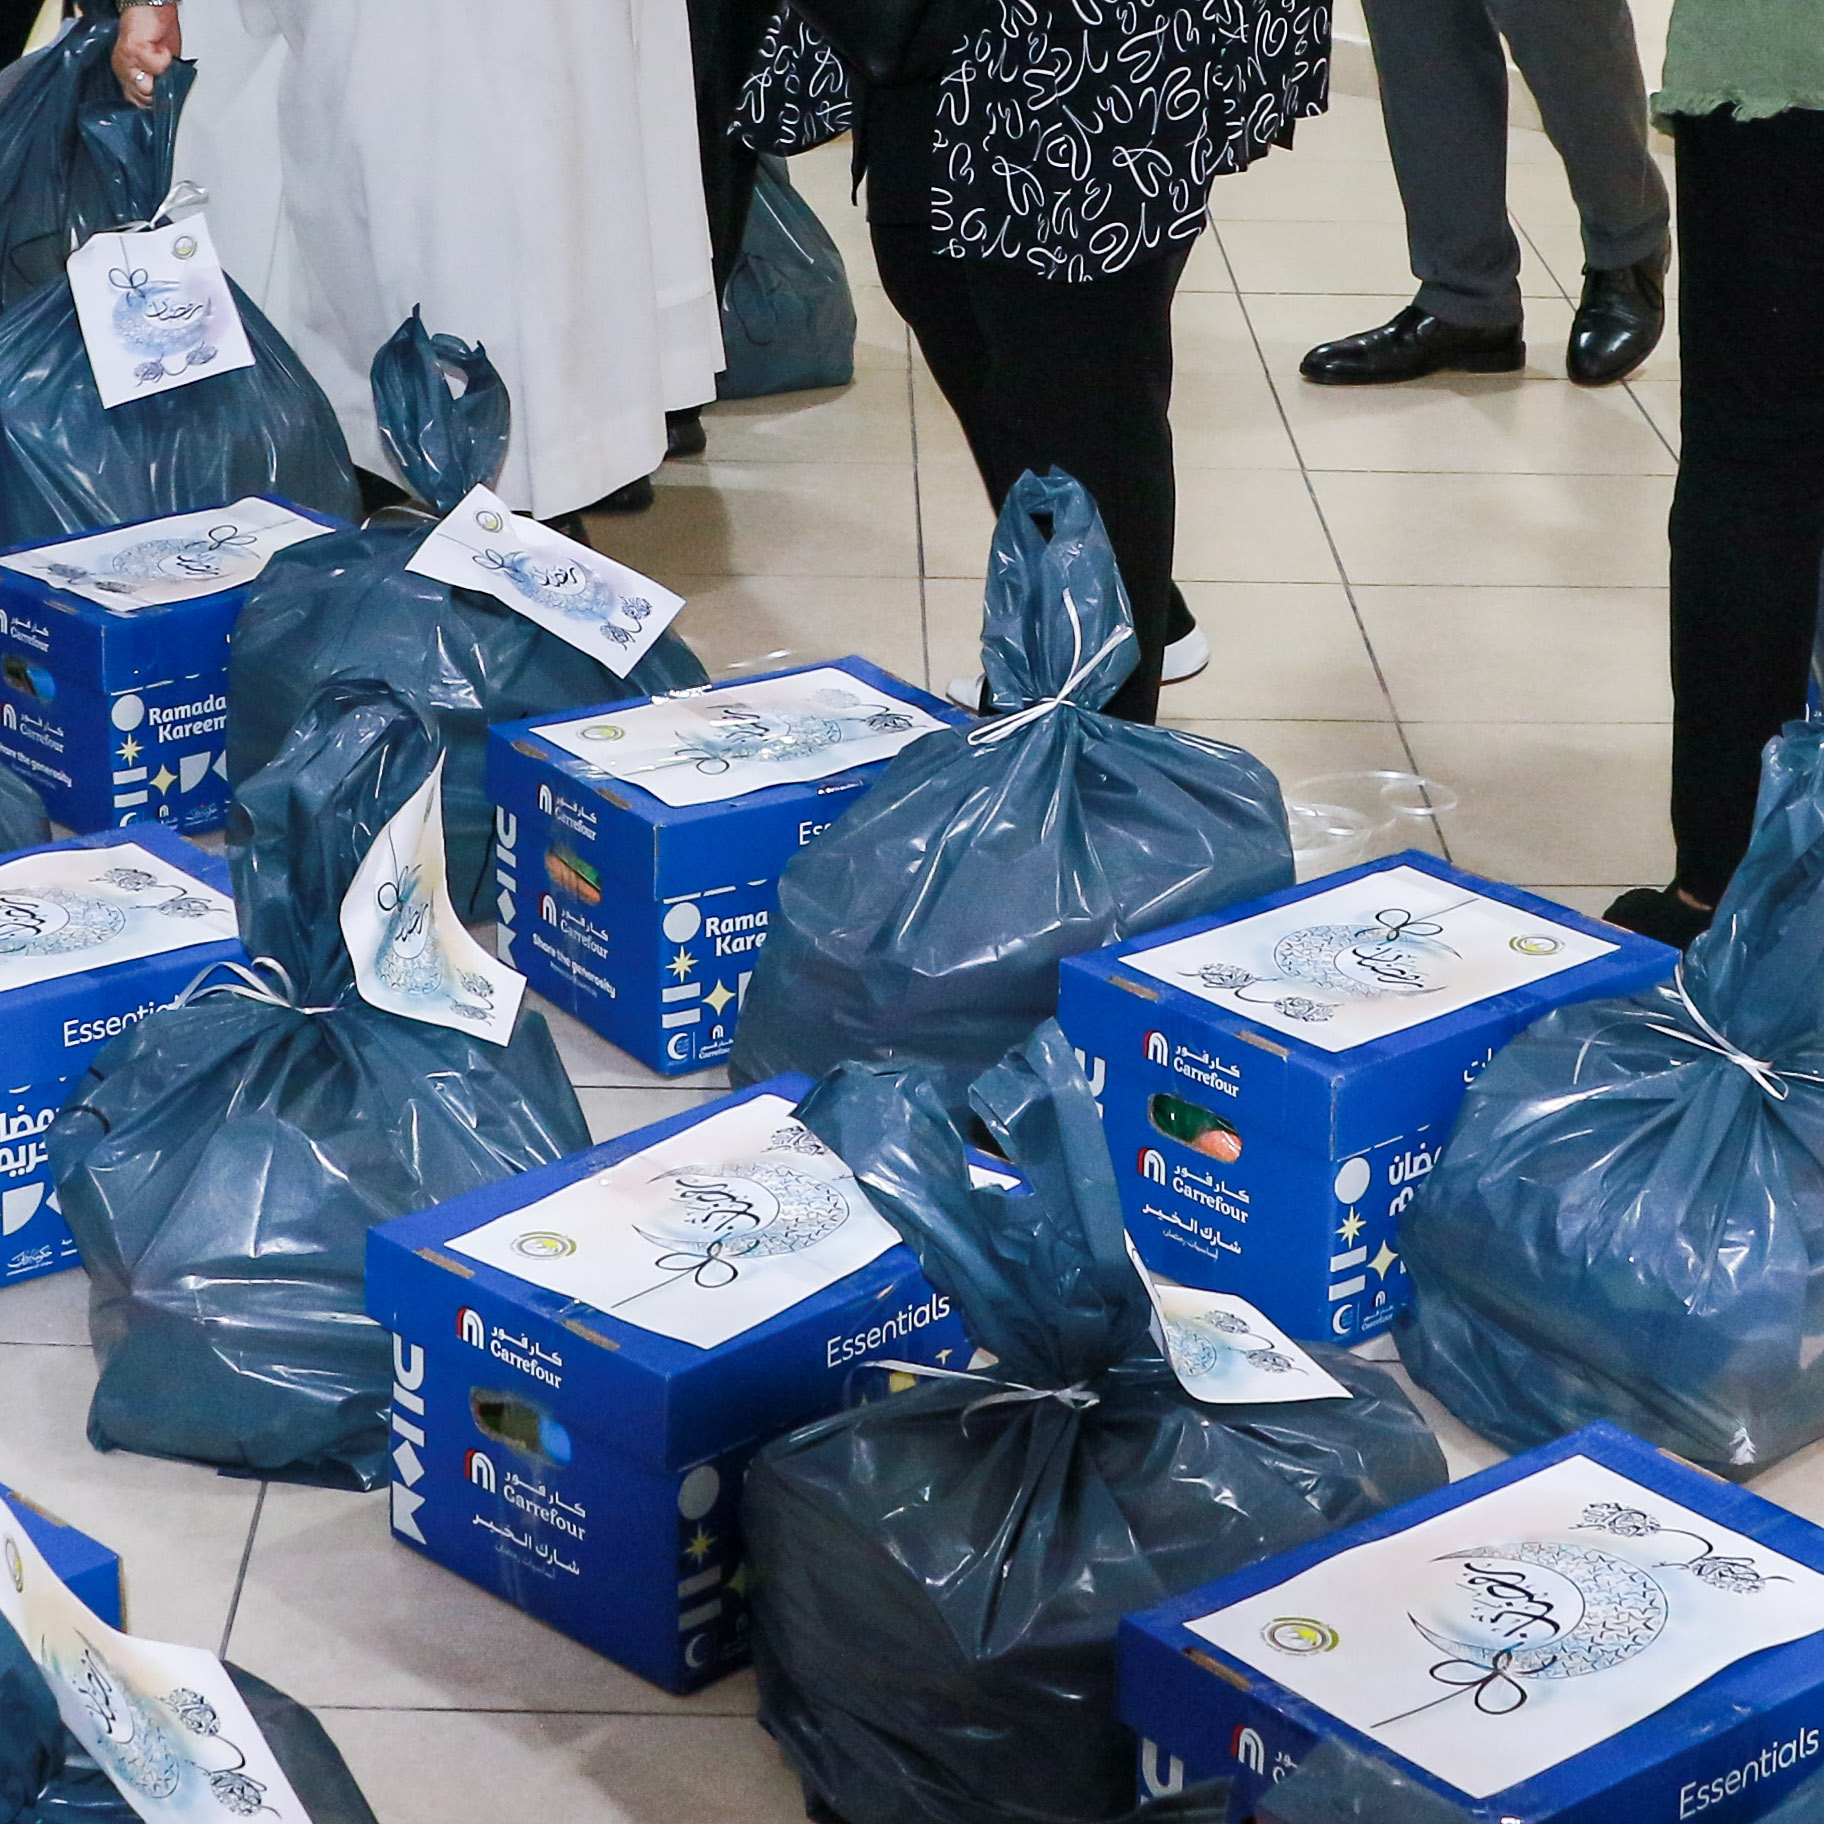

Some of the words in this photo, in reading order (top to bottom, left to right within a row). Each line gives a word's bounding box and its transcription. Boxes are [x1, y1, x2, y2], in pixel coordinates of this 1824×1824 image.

[149, 694, 226, 726] Ramada
[555, 808, 596, 841] Carrefour
[561, 919, 608, 959] Carrefour
[706, 910, 768, 938] Rama
[716, 931, 766, 956] Kare
[1174, 1058, 1239, 1098] Carrefour
[1176, 1044, 1240, 1078] كارفور
[1173, 1177, 1248, 1224] Carrefour
[1174, 1164, 1249, 1204] كارفور
[1143, 1202, 1198, 1236] الخير
[1200, 1225, 1242, 1255] شارك
[492, 1326, 562, 1366] كارفور
[827, 1292, 950, 1370] Essentials
[491, 1338, 562, 1389] Carrefour
[504, 1485, 585, 1541] Carrefour
[505, 1472, 585, 1518] كارفور
[473, 1512, 531, 1549] الخير
[536, 1544, 579, 1575] شارك
[1679, 1729, 1820, 1820] Essentials
